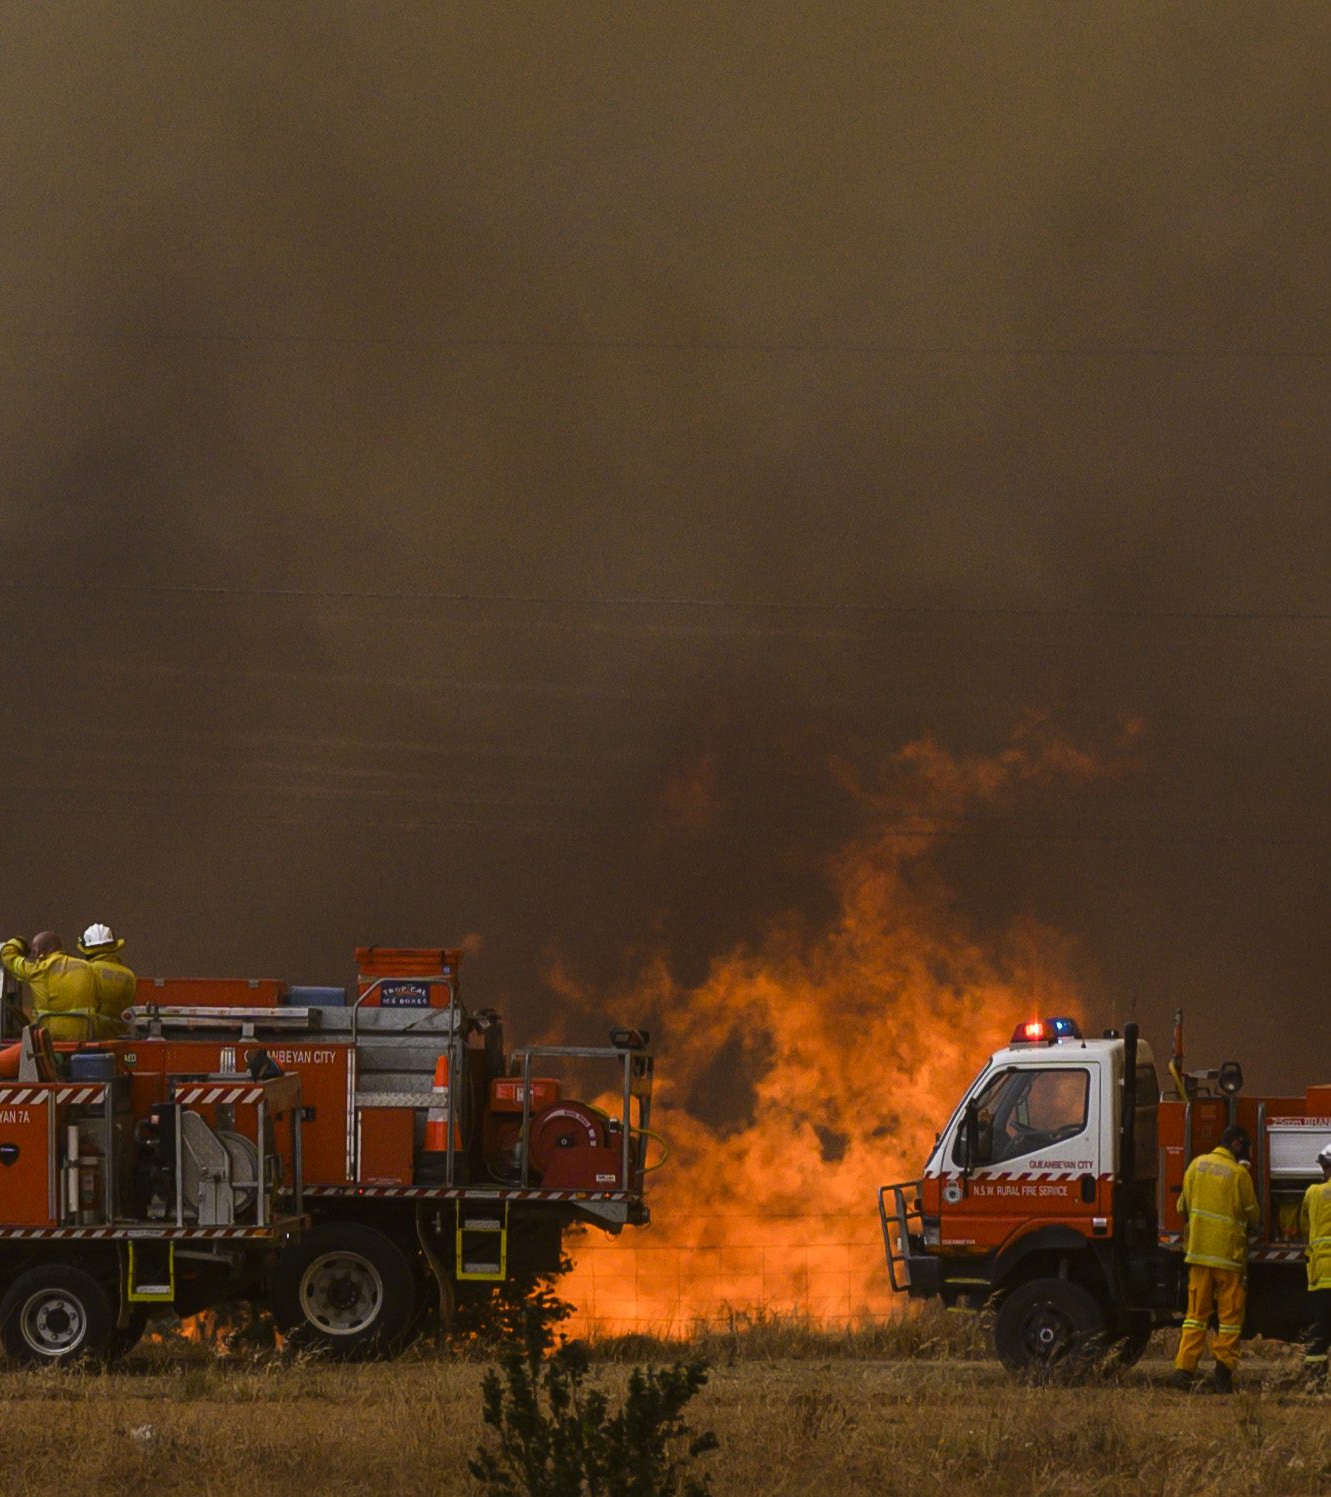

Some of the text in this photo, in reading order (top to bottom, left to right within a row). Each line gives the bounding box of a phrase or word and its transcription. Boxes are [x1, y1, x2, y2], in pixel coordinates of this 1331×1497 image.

[244, 1050, 336, 1063] ANBEYAN CITY
[18, 1110, 30, 1123] 7A
[1029, 1160, 1094, 1169] QUEANBEYAN CITY
[973, 1185, 1068, 1197] N.S.W. RURAL FIRE SERVICE
